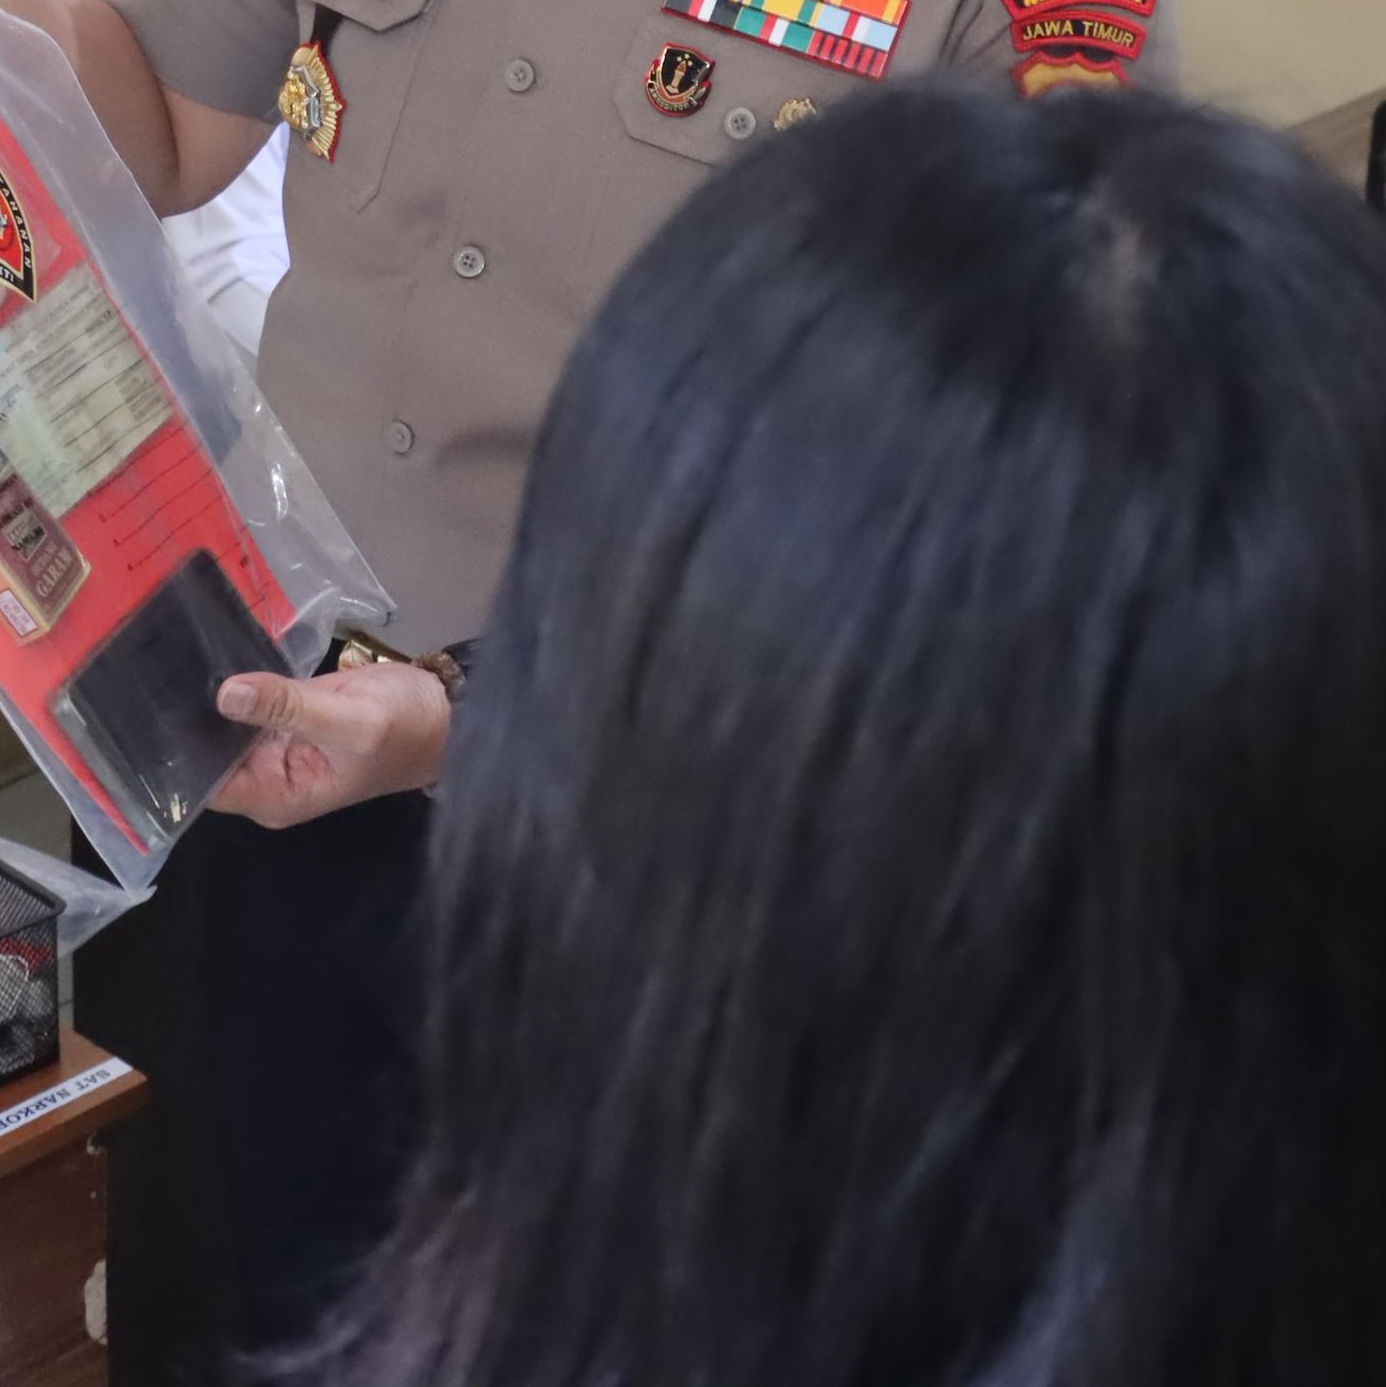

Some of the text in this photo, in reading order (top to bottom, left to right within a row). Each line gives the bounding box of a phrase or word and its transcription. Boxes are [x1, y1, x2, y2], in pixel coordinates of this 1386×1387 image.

[1023, 19, 1135, 48] JAWA TIMUR
[74, 1069, 111, 1093] SAT
